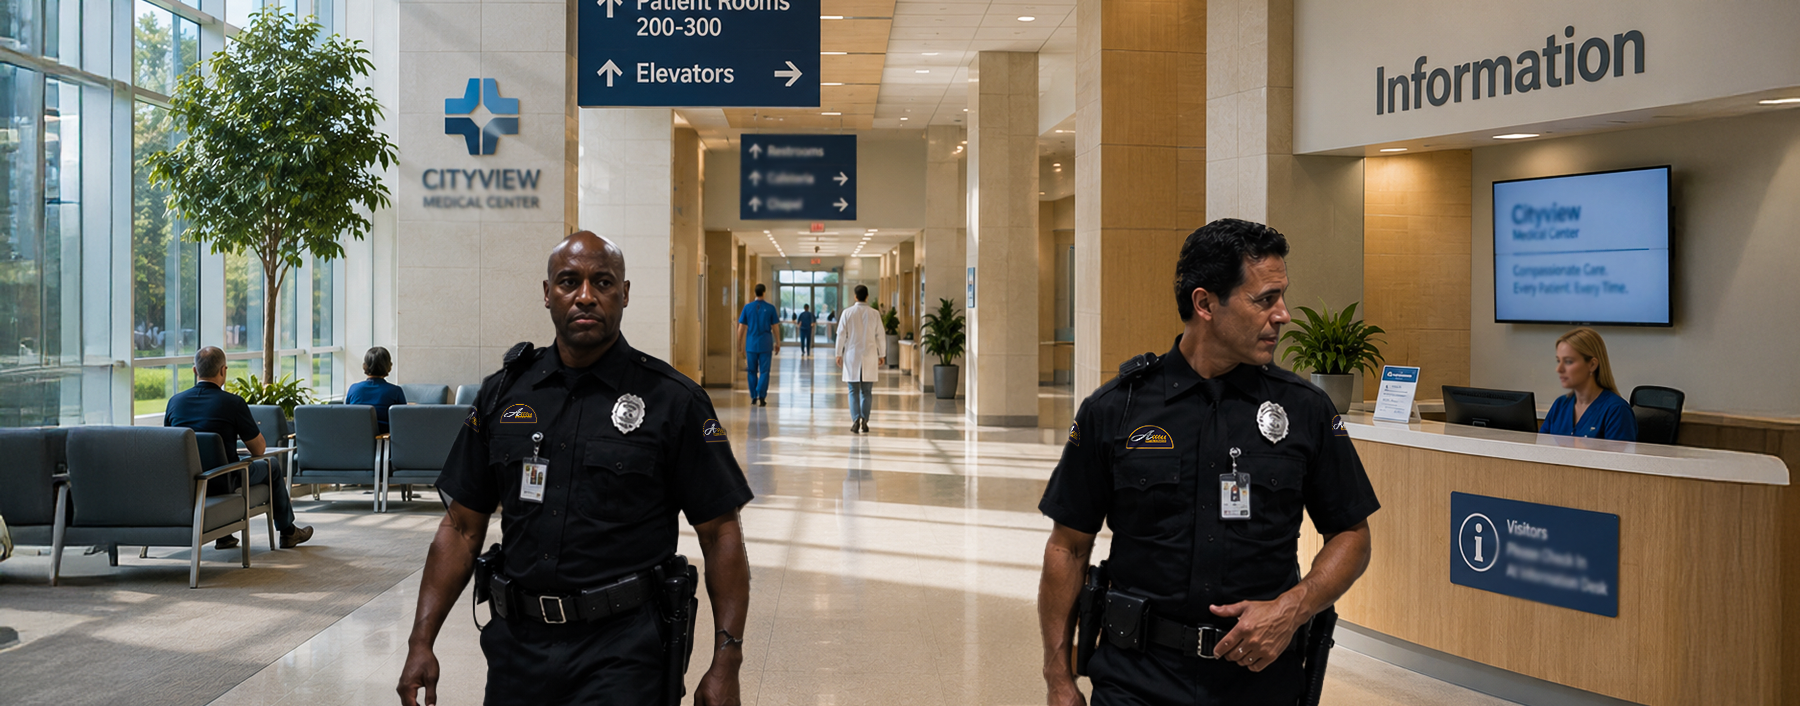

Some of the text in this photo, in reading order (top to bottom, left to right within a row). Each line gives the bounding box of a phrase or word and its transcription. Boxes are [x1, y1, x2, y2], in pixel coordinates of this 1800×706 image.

[637, 17, 722, 37] 200-300
[636, 62, 735, 84] Elevators
[1376, 25, 1645, 116] Information
[422, 168, 541, 190] CITYVIEW
[423, 195, 540, 209] MEDICAL CENTER
[1512, 203, 1581, 227] Cityview
[1506, 519, 1549, 541] Visitors
